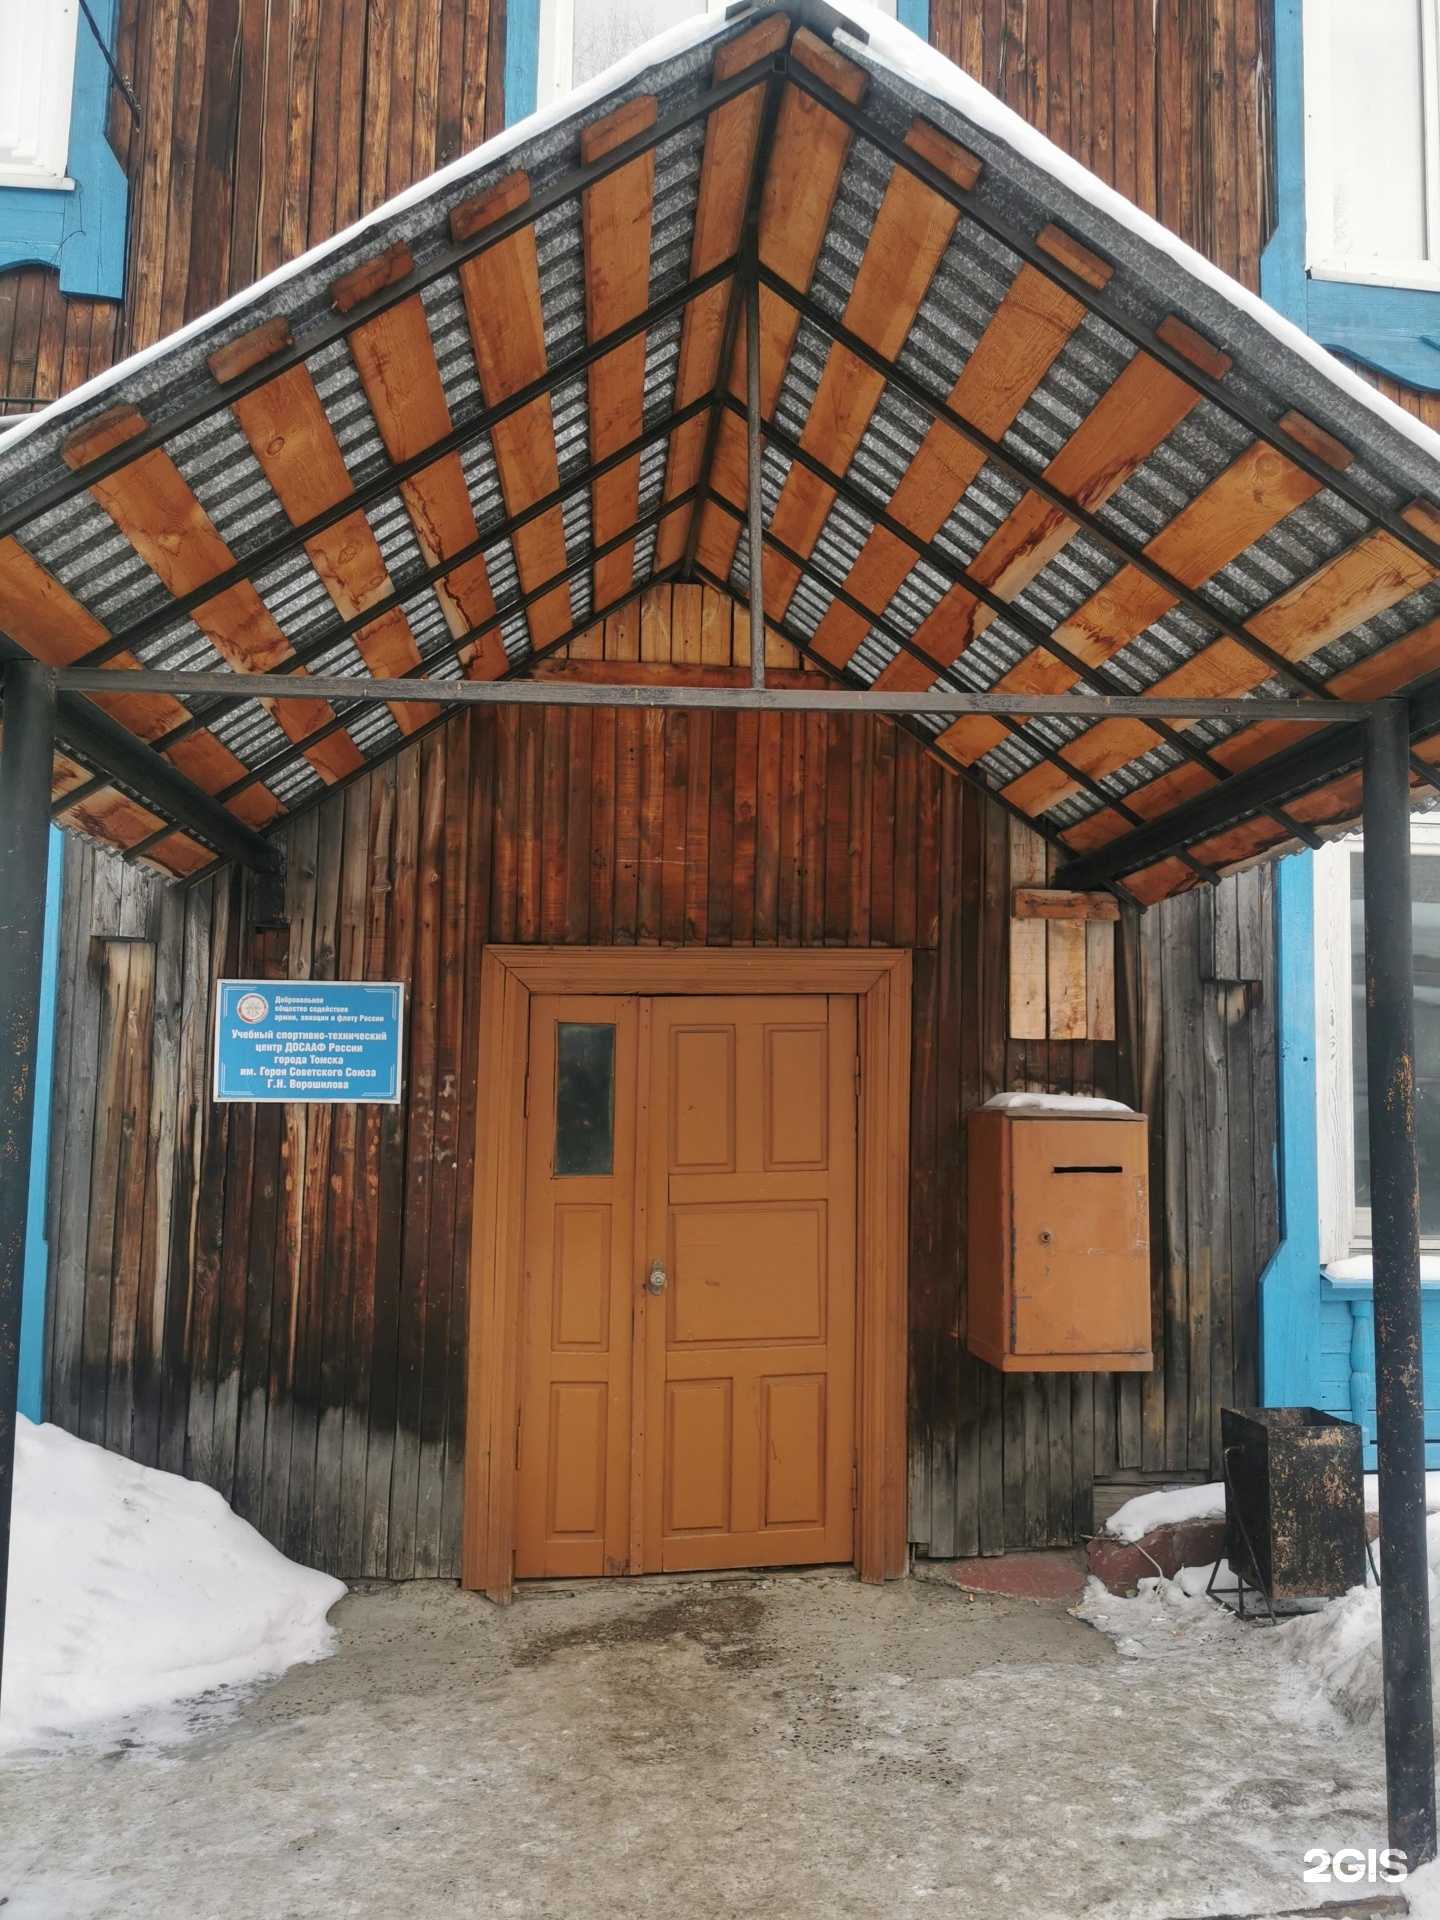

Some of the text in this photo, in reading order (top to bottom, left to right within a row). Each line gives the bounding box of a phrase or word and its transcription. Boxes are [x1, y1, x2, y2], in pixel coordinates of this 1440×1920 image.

[232, 1029, 387, 1040] Учебный спортивно-технический
[256, 1043, 363, 1053] центр ДОСААФ России
[274, 1056, 343, 1065] города Томска
[259, 1067, 286, 1077] Героя
[290, 1067, 342, 1076] Советского
[346, 1068, 376, 1077] Союза
[268, 1080, 349, 1090] Г.Н. Ворошилова
